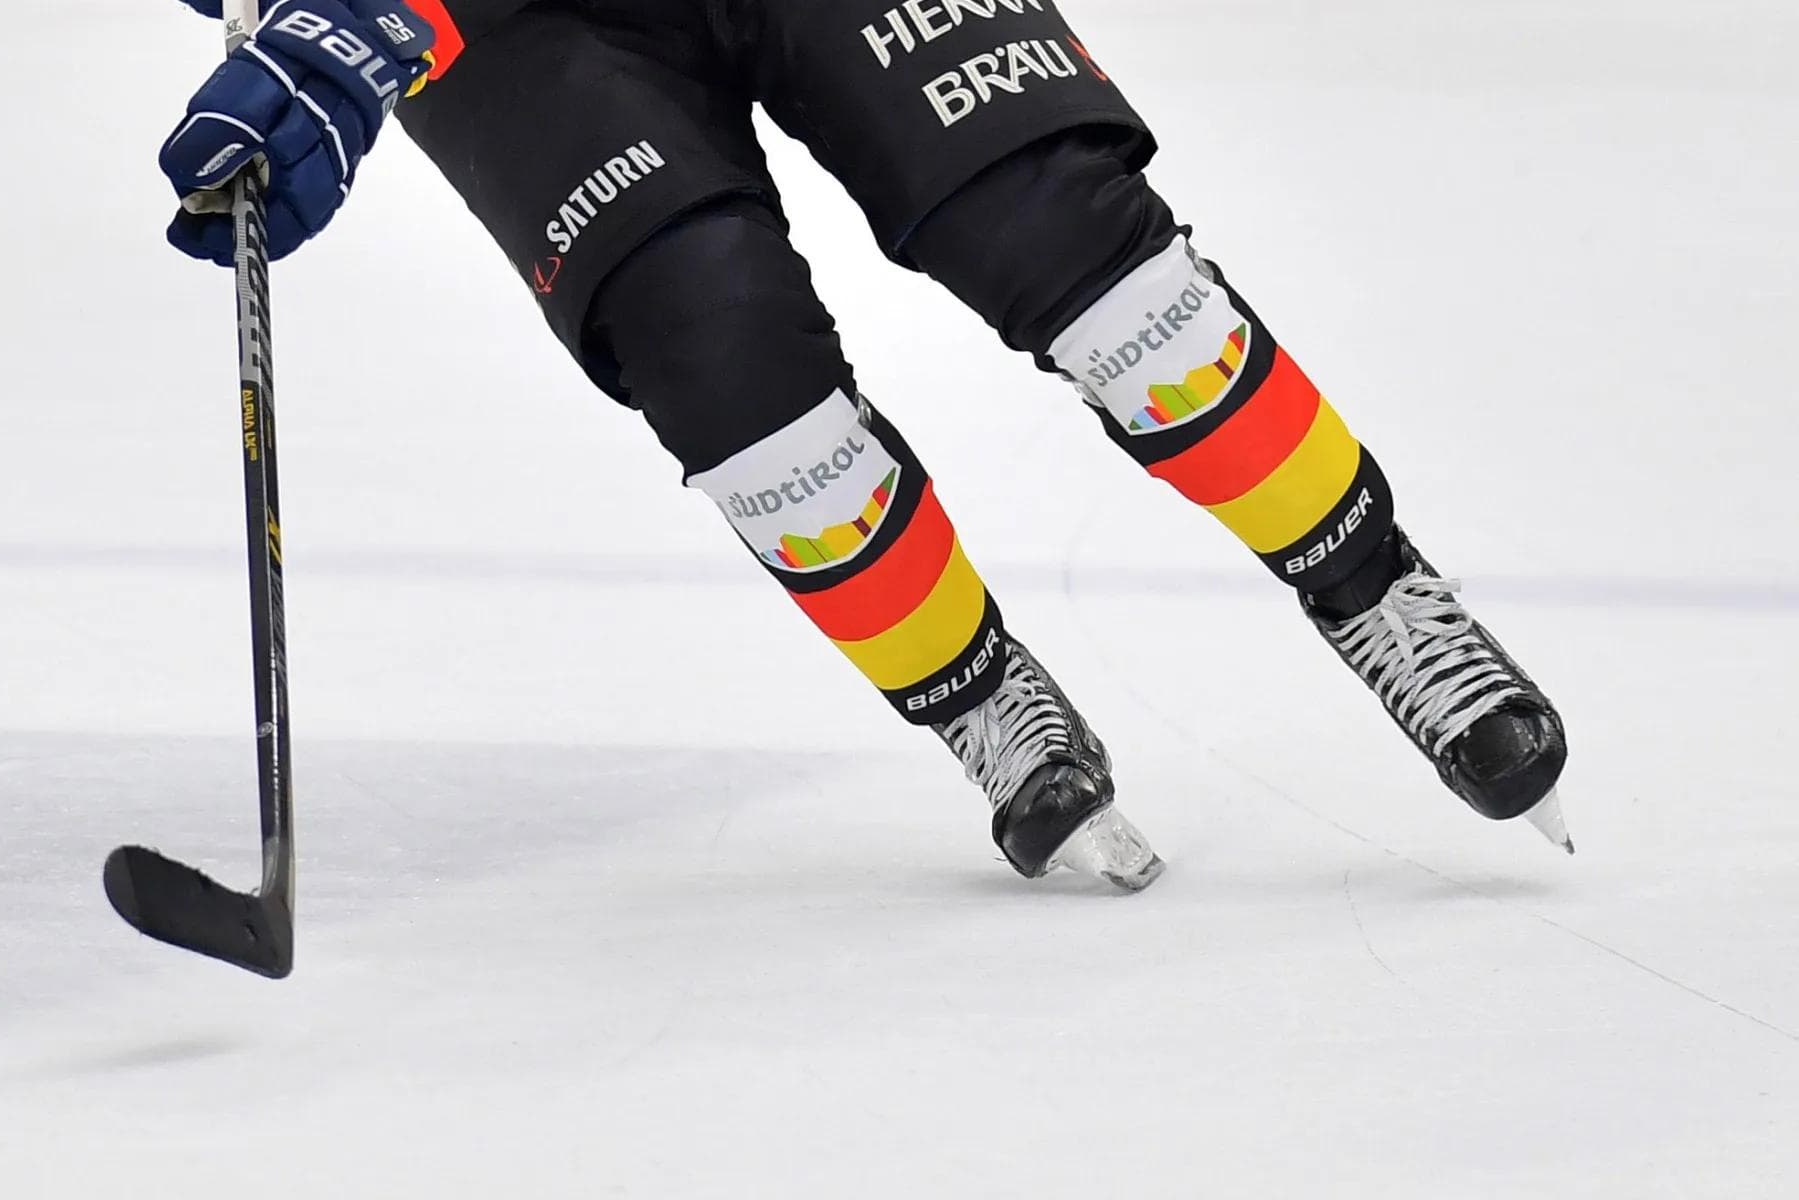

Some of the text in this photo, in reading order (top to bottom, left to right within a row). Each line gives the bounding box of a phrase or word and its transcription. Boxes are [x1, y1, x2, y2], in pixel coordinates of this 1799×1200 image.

[921, 39, 1078, 127] BRÄU
[546, 140, 666, 254] SATURN
[1285, 487, 1374, 575] BAUER
[906, 627, 1000, 711] BAUER
